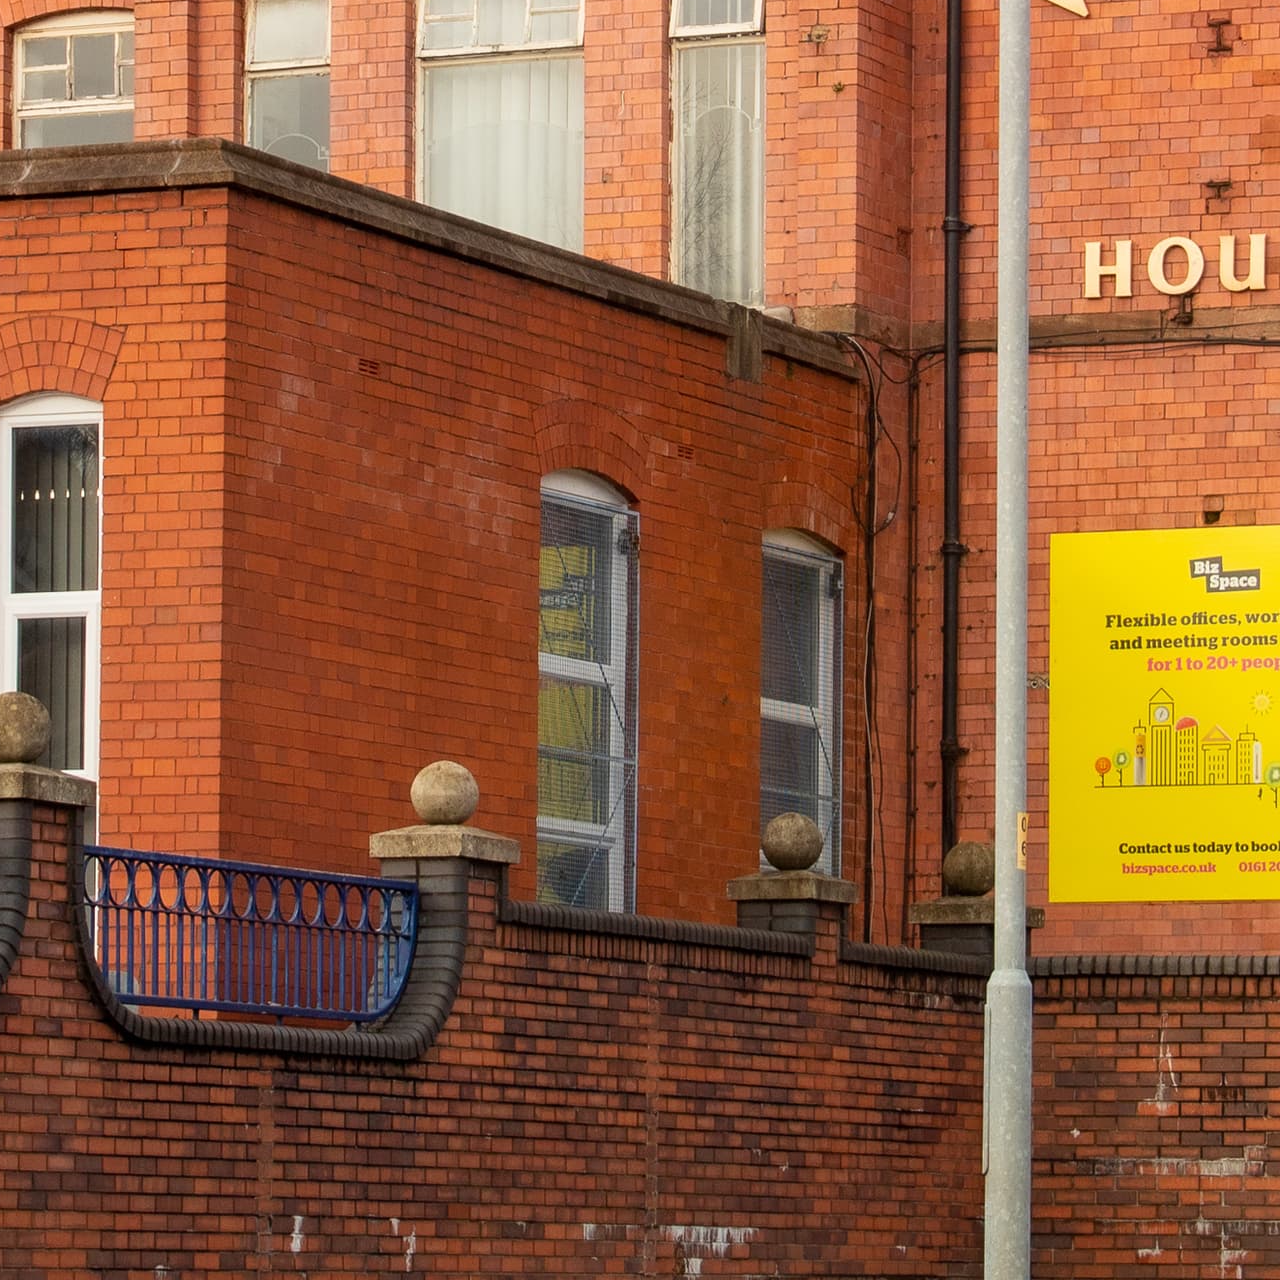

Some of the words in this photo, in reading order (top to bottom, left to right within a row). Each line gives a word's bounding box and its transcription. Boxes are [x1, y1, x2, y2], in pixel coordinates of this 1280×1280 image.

[1194, 560, 1220, 575] Biz
[1209, 574, 1258, 591] Space
[1105, 612, 1178, 628] Flexible
[1181, 610, 1242, 626] offices,
[1109, 636, 1143, 650] and
[1146, 634, 1218, 650] meeting
[1222, 633, 1278, 647] rooms
[1147, 658, 1172, 672] for
[1175, 658, 1183, 671] 1
[1186, 657, 1204, 670] to
[1206, 655, 1238, 670] 20+
[1119, 842, 1172, 855] Contact
[1174, 844, 1191, 854] us
[1193, 842, 1232, 855] today
[1235, 842, 1249, 852] to
[1121, 862, 1217, 876] bizspace.co.uk
[1238, 862, 1267, 872] 0161
